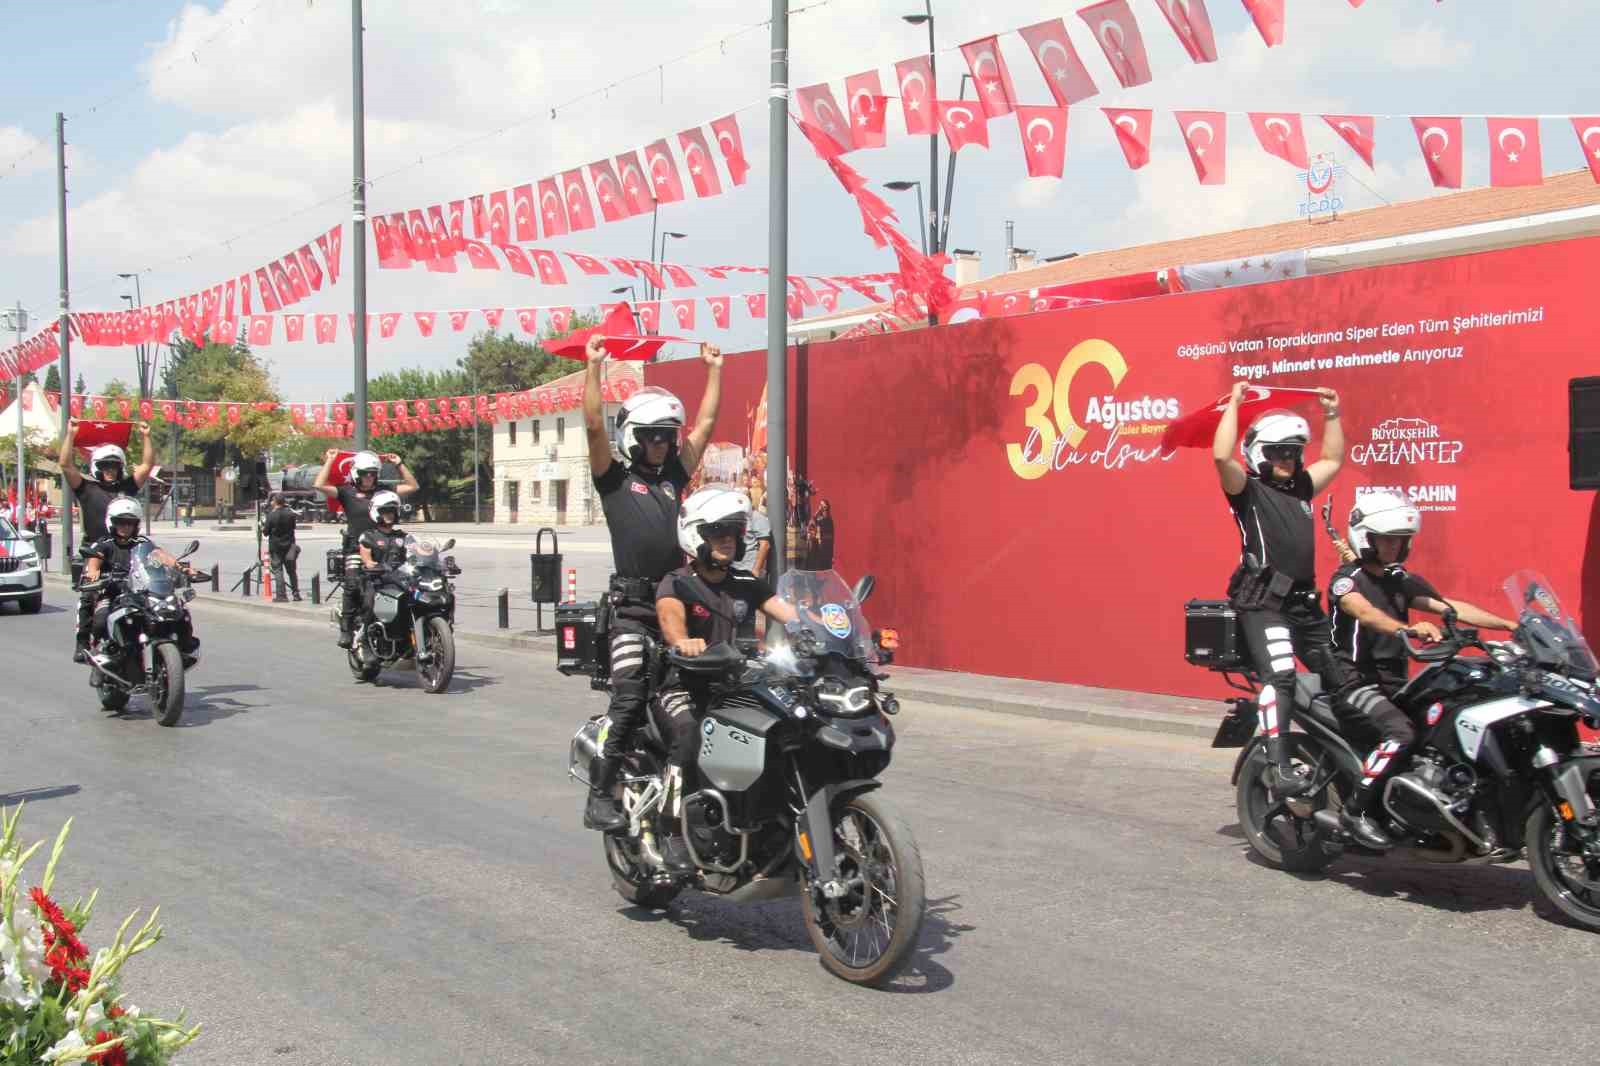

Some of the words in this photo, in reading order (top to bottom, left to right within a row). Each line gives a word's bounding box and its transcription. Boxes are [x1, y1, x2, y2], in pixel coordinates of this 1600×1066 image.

[1177, 343, 1227, 360] Göğsünü
[1229, 339, 1264, 353] Vatan
[1267, 331, 1343, 352] Topraklarına
[1346, 326, 1379, 343] Siper
[1382, 323, 1416, 337] Eden
[1418, 318, 1449, 333] Tüm
[1453, 307, 1544, 335] Şehitlerimizi
[1232, 364, 1270, 379] Saygı,
[1272, 359, 1316, 374] Minnet
[1318, 359, 1333, 369] ve
[1335, 350, 1400, 368] Rahmetle
[1402, 346, 1464, 364] Anıyoruz
[1085, 395, 1179, 430] Ağustos
